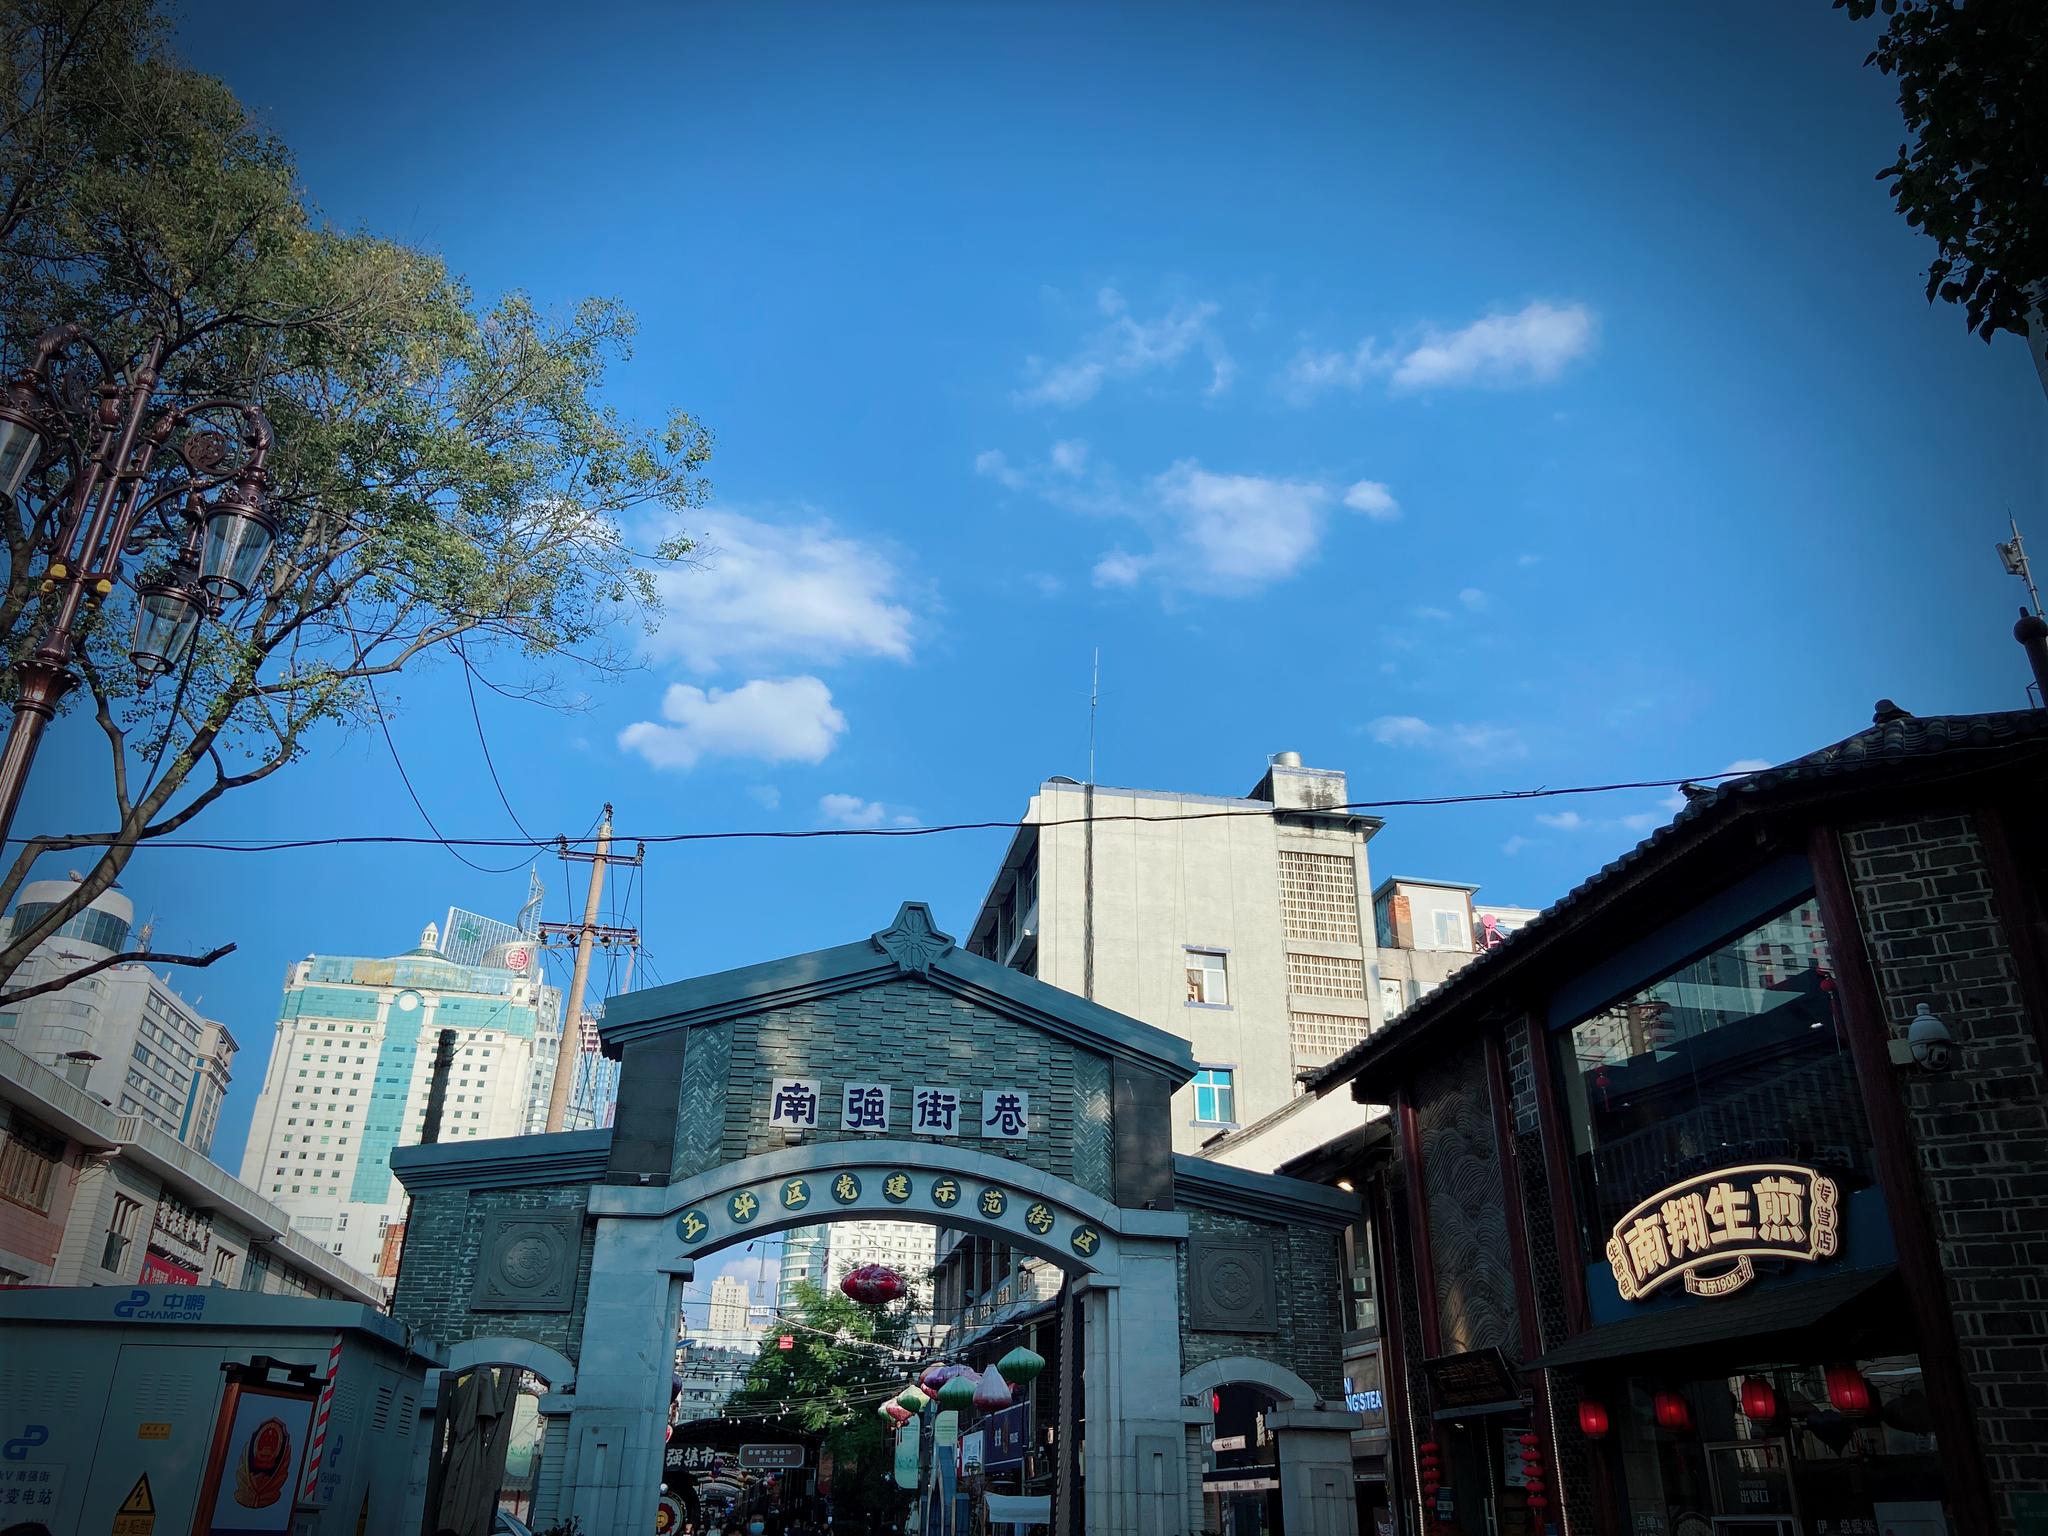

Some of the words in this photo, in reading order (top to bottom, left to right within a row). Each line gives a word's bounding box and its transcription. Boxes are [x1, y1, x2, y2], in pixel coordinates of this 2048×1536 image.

[681, 1173, 1098, 1254] 五华区党建示范街区
[1623, 1175, 1807, 1282] 南翔生煎
[1816, 1182, 1832, 1251] 专营店
[137, 1310, 203, 1321] CHAMPON
[163, 1293, 206, 1310] 中鹏
